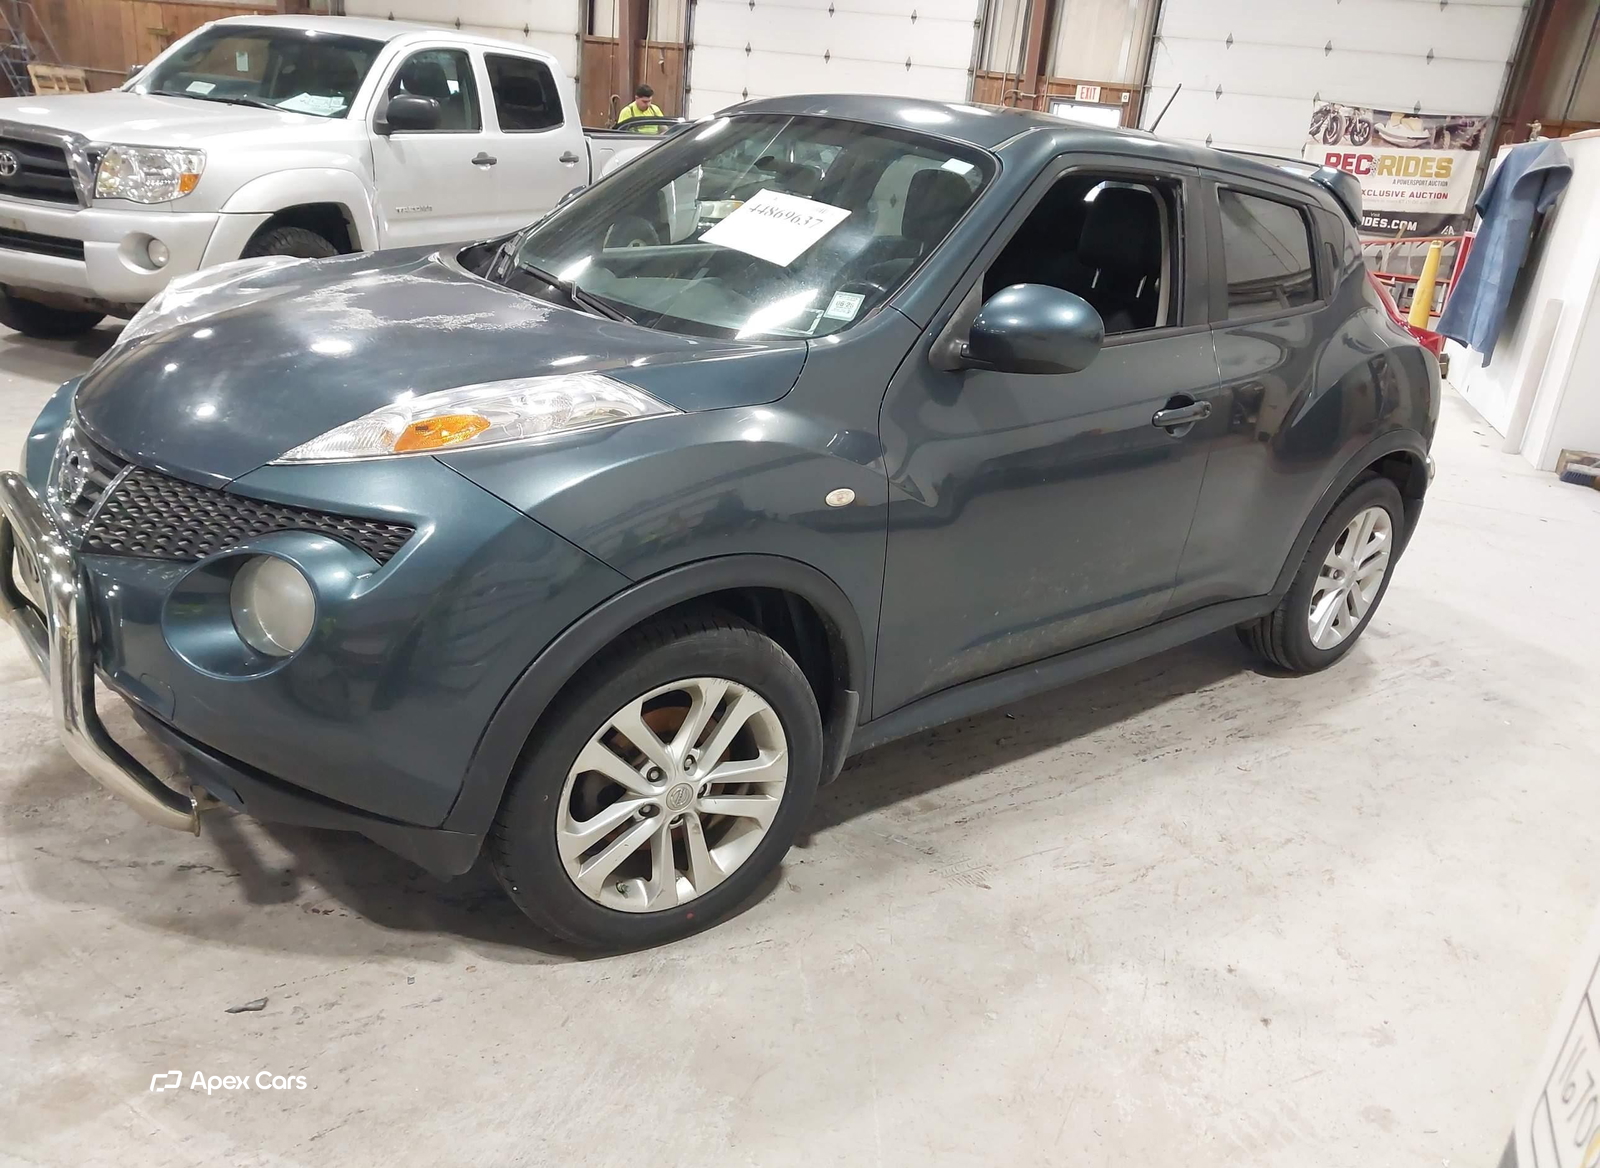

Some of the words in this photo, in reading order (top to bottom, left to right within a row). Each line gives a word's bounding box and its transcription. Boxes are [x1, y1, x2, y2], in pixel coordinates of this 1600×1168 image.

[1080, 86, 1097, 100] EXIT
[1377, 154, 1454, 179] RIDES
[1428, 180, 1449, 188] AUCTION
[1361, 189, 1407, 198] XCLUSIVE
[1408, 191, 1449, 200] AUCTION
[748, 203, 825, 229] 44869637
[1361, 216, 1418, 232] IDES.COM
